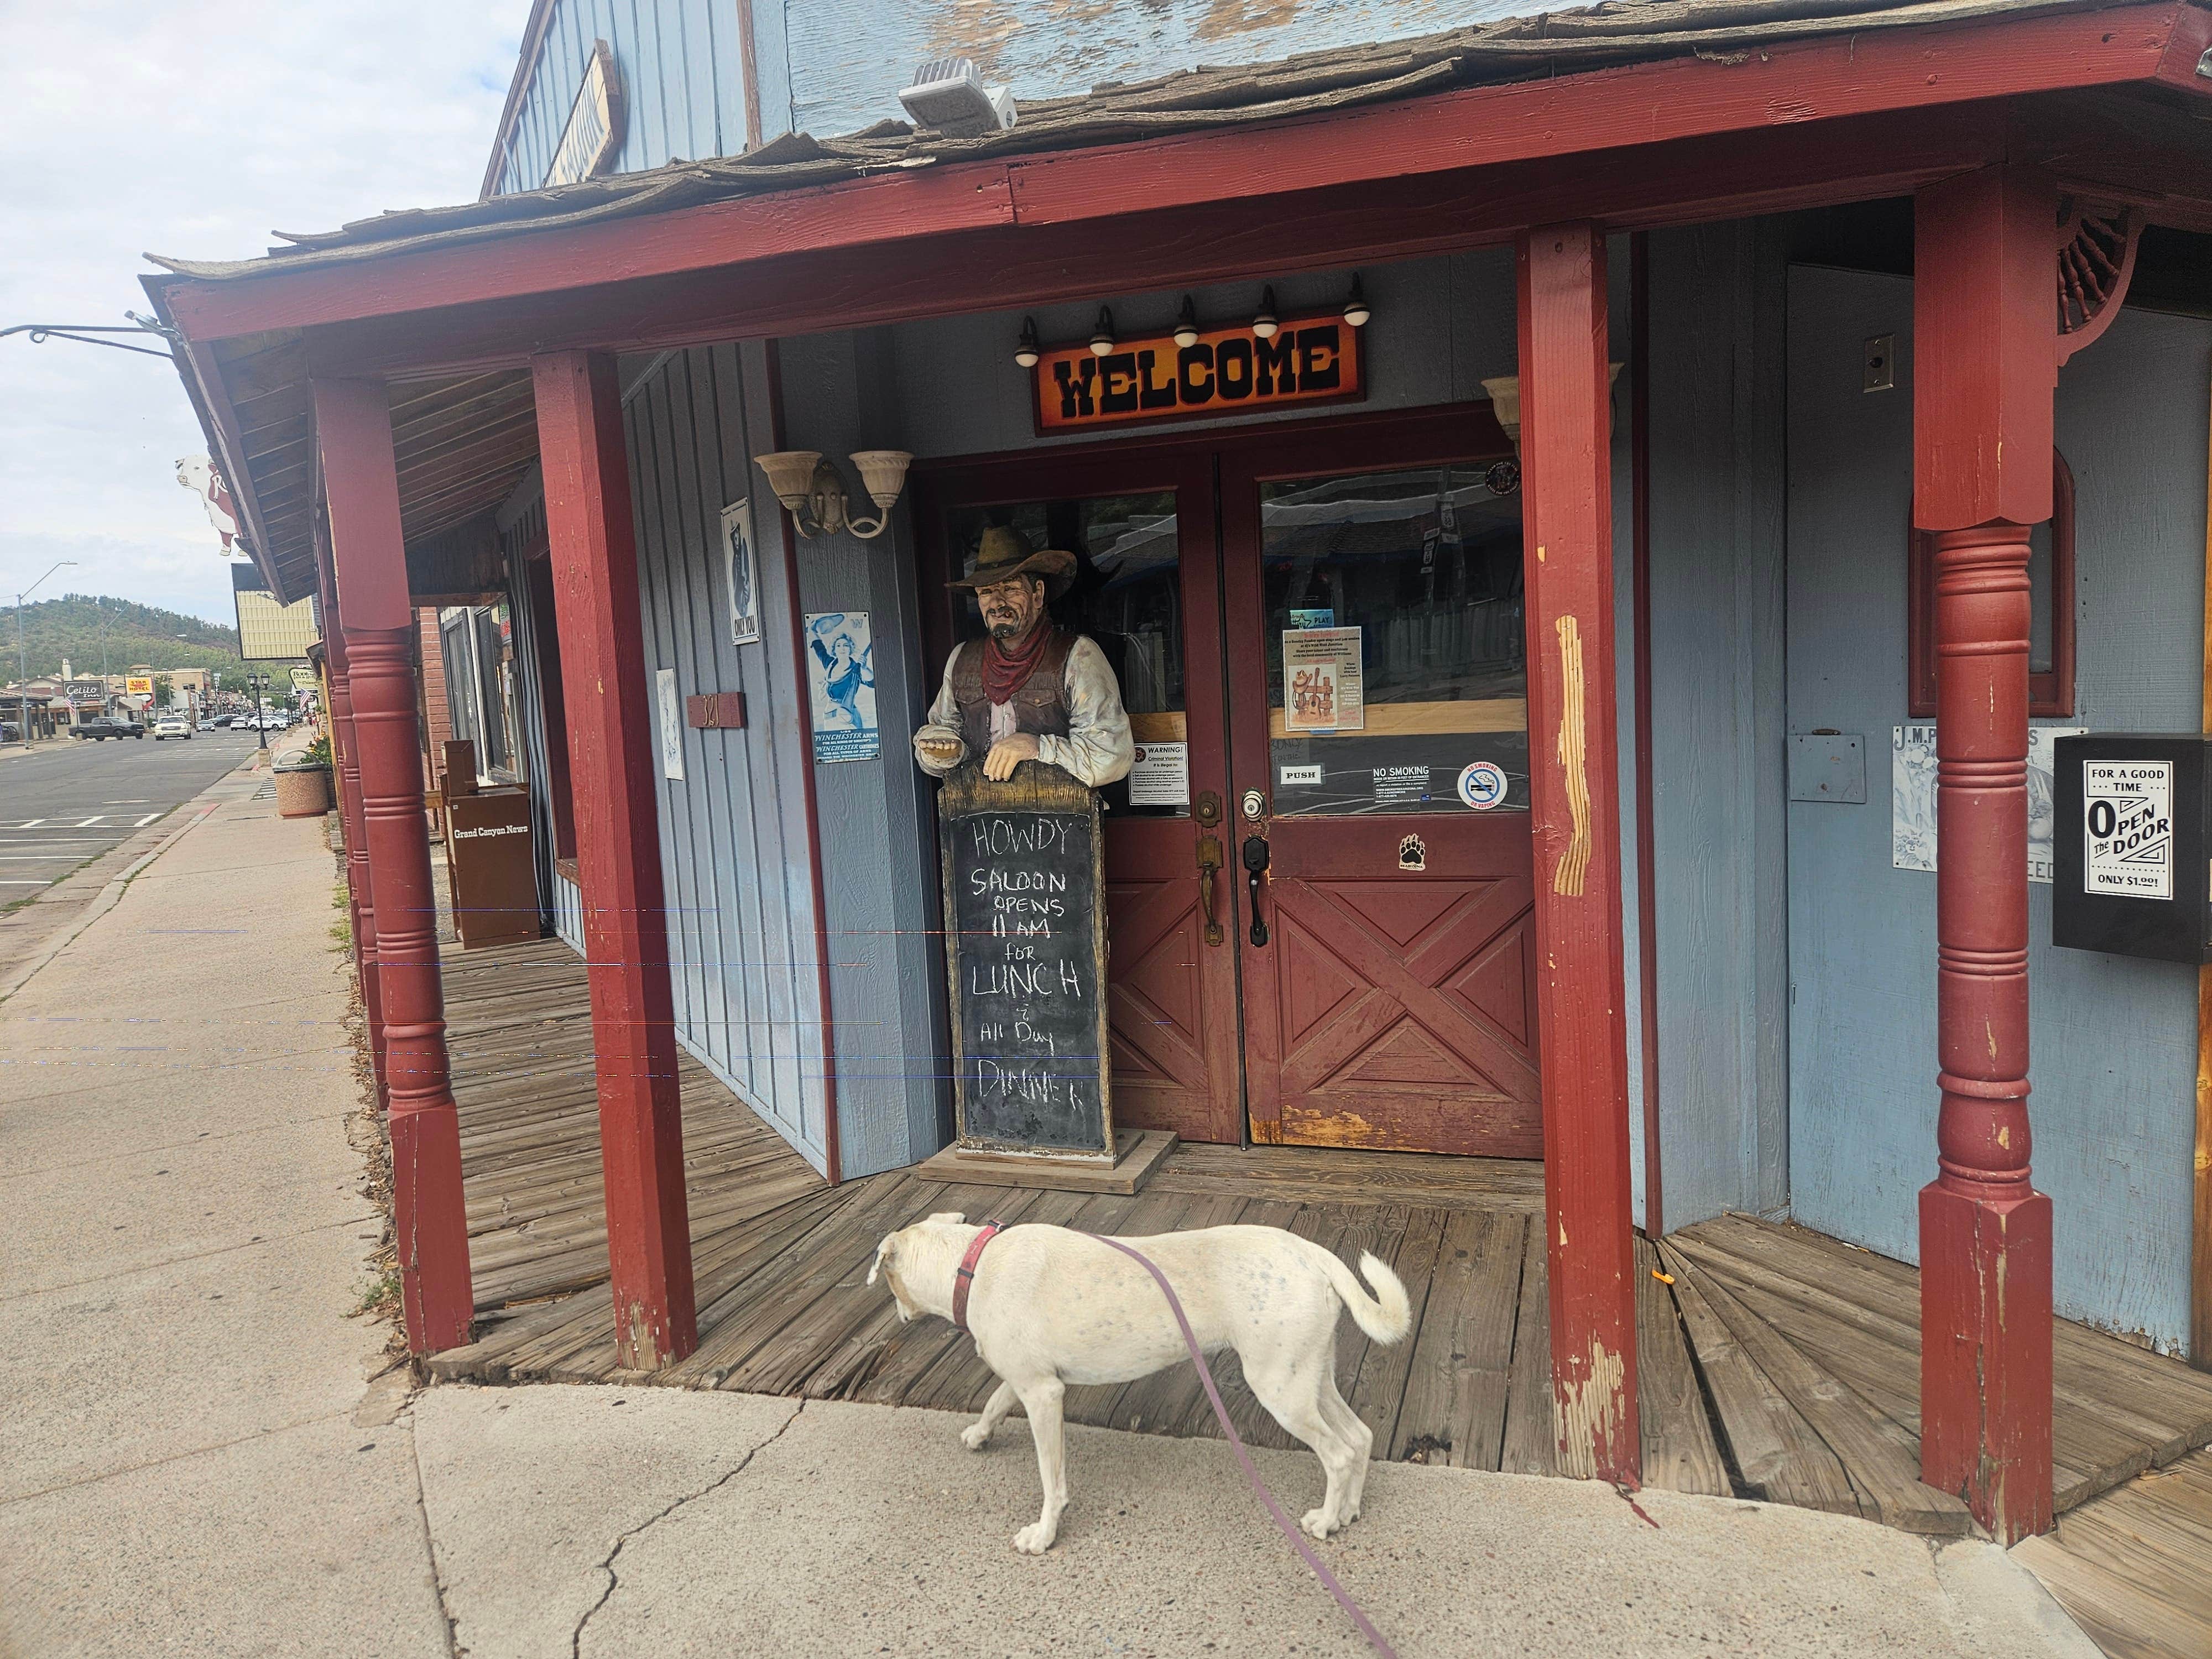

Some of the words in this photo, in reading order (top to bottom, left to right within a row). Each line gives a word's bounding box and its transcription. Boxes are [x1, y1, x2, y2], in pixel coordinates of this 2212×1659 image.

[1053, 325, 1339, 419] WELCOME
[735, 618, 744, 637] ONLY
[745, 615, 755, 634] YOU
[815, 733, 862, 741] WINCHESTER
[1373, 768, 1386, 777] NO
[1390, 766, 1429, 776] SMOKING
[1474, 763, 1498, 772] SMOKING
[2093, 769, 2114, 778] FOR
[2119, 770, 2127, 778] A
[2131, 769, 2164, 779] GOOD
[2113, 782, 2142, 792] TIME
[2088, 800, 2154, 839] OPEN
[455, 828, 478, 838] Grand
[478, 827, 505, 838] Canyon
[506, 825, 528, 834] News
[973, 817, 1070, 857] HOWDY
[2094, 840, 2109, 854] The
[2113, 818, 2170, 854] DOOR
[971, 868, 1066, 895] SALOON
[2098, 874, 2125, 885] ONLY
[994, 895, 1065, 916] OPENS
[992, 914, 1006, 938] 11
[1016, 919, 1050, 938] AM
[973, 959, 1081, 998] LUNCH
[979, 1060, 1084, 1110] DINNER
